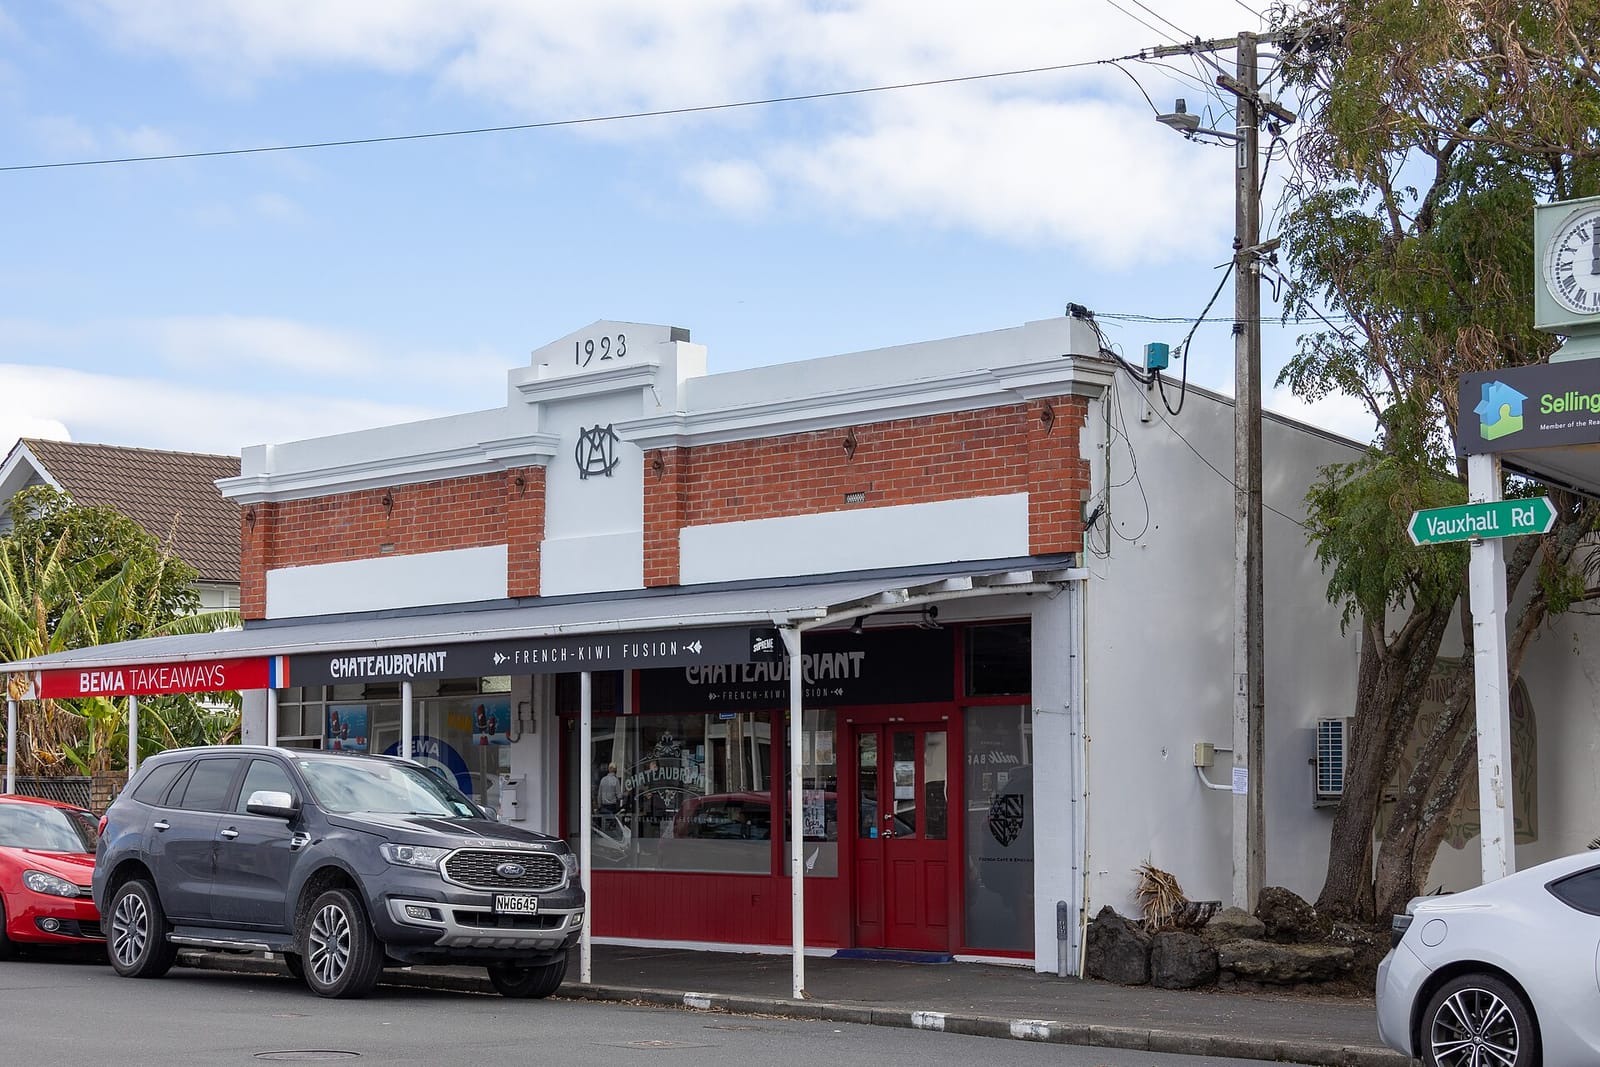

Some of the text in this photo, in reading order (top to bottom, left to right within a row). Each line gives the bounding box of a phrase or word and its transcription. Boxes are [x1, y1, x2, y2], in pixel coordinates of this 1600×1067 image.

[575, 334, 627, 367] 1923
[1540, 391, 1600, 414] Selling
[1427, 506, 1535, 536] Vauxhall Rd
[515, 641, 677, 664] FRENCH-KIWI FUSION
[330, 651, 447, 678] CHATEAUBRIANT
[80, 665, 225, 692] BEMA TAKEAWAYS
[722, 687, 828, 700] FRENCH-KIWI SION
[504, 865, 521, 874] Ford
[496, 897, 536, 911] NWG645
